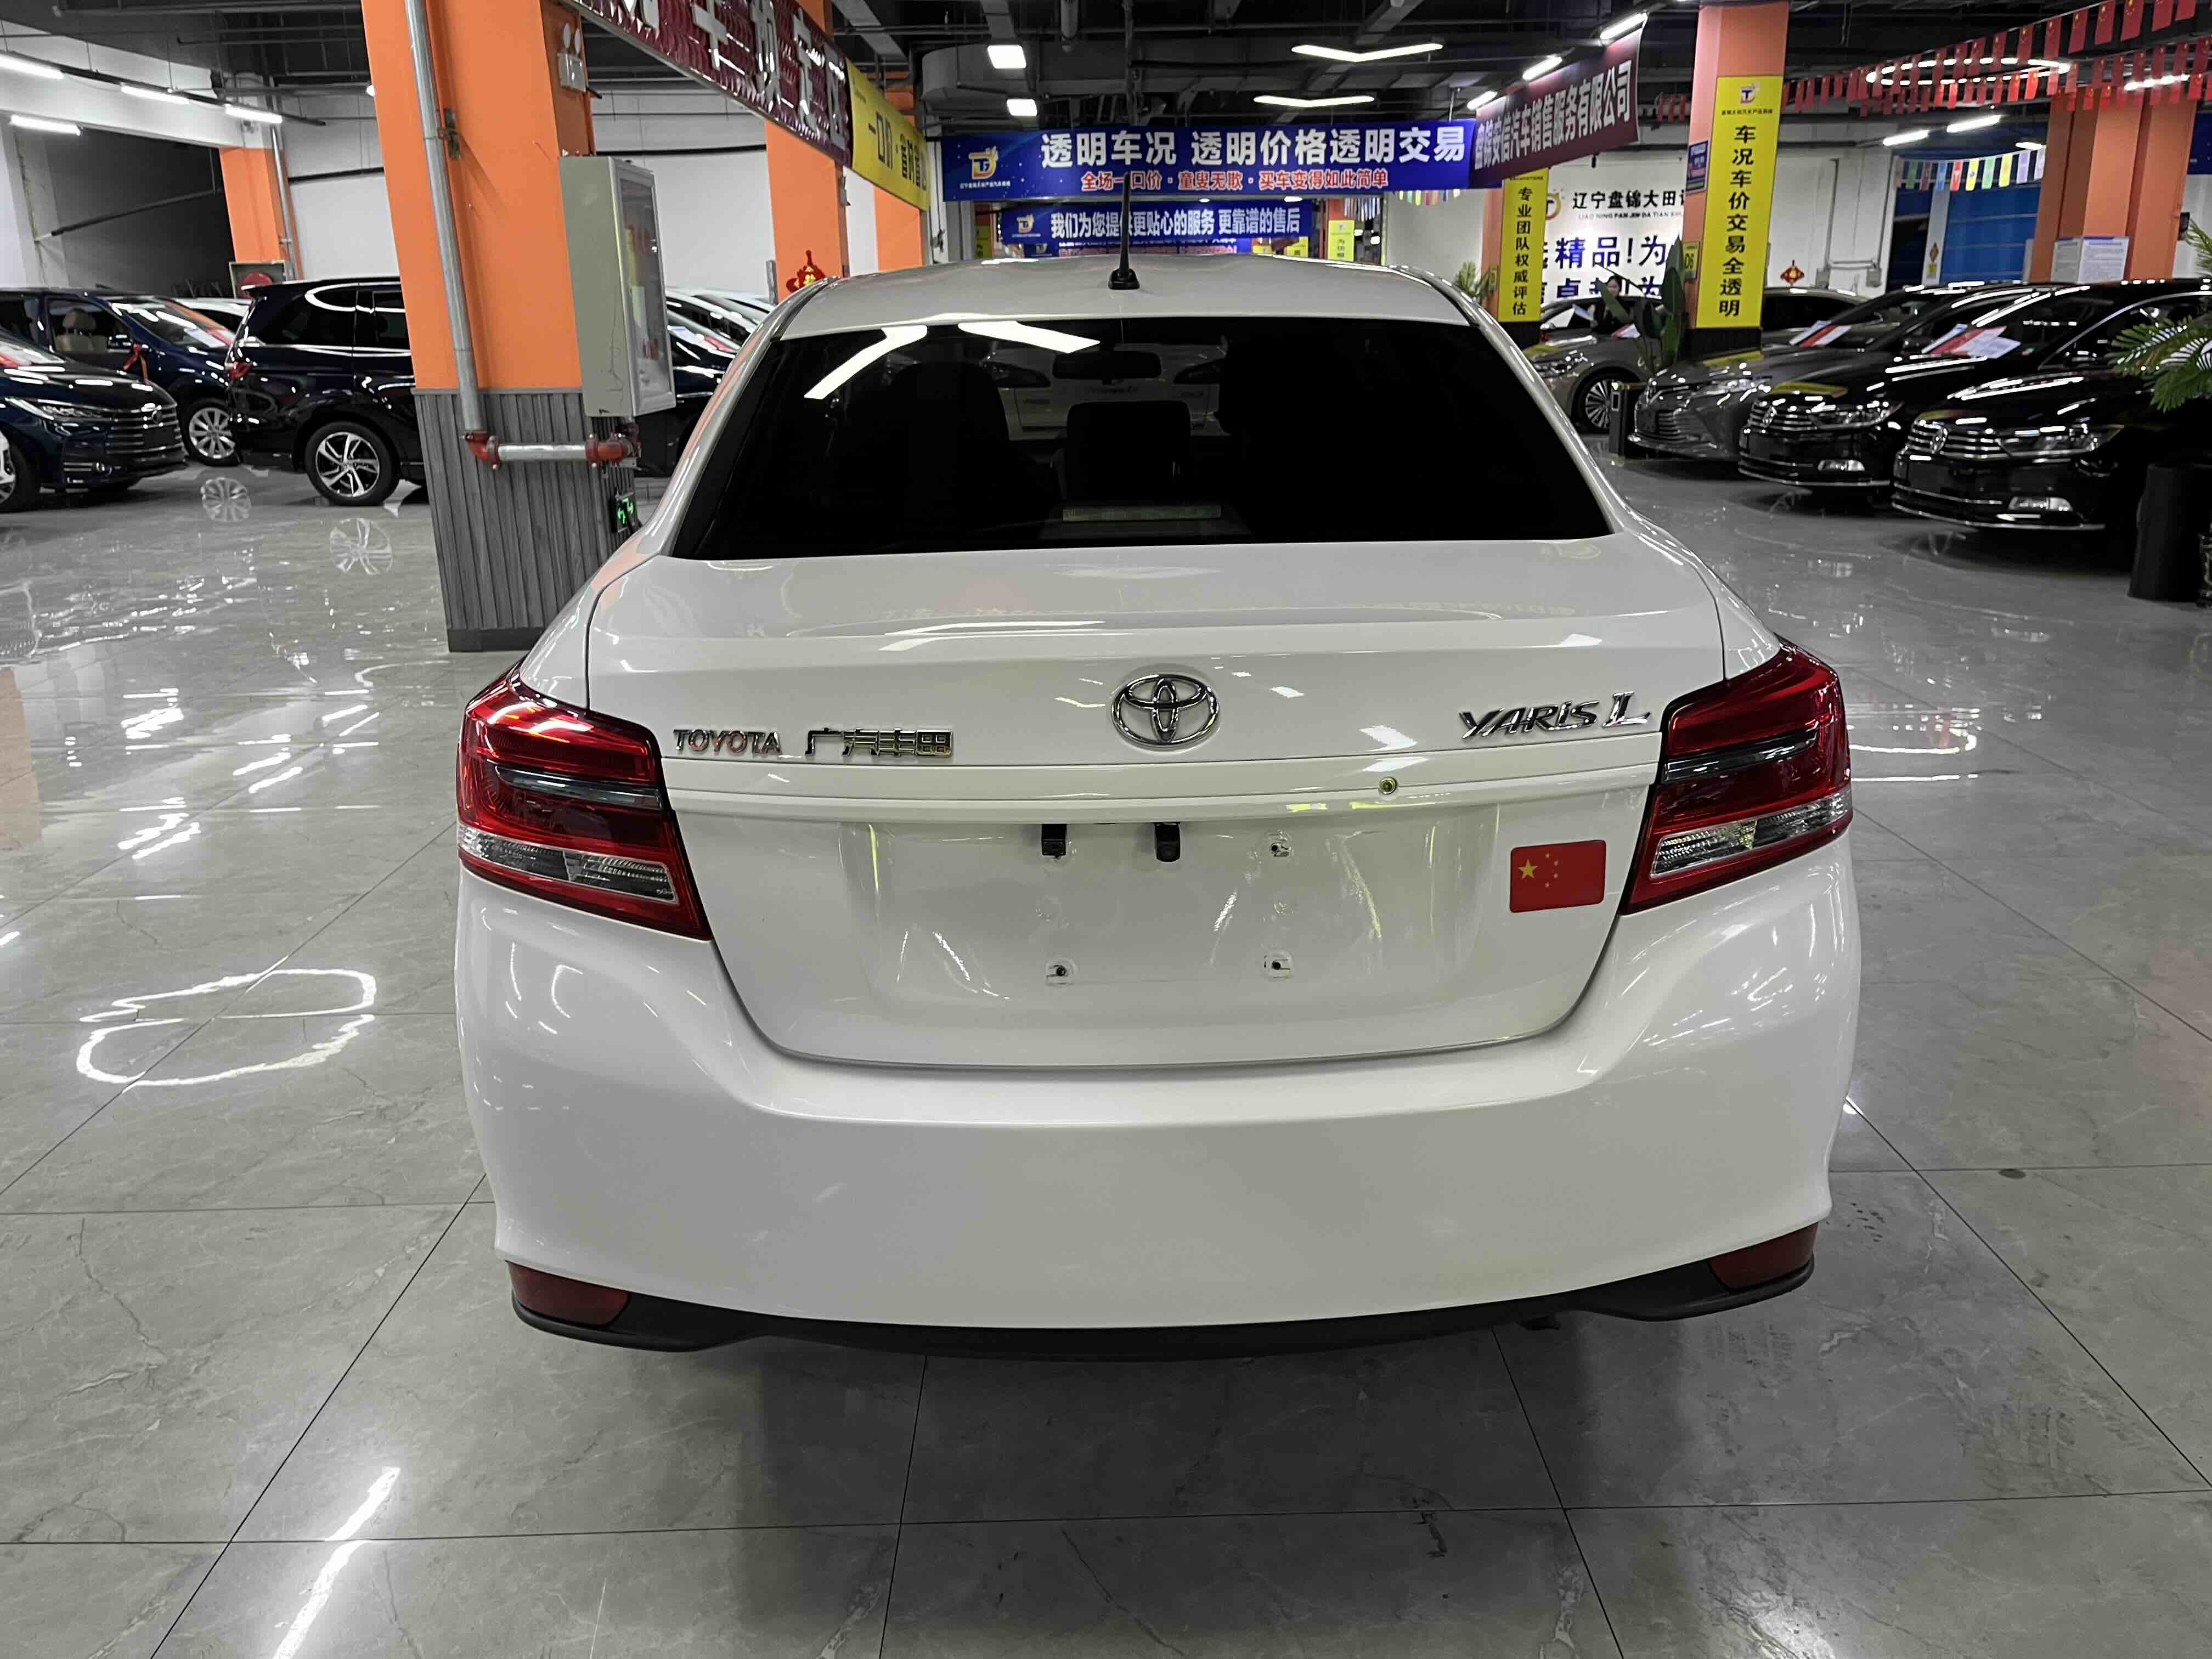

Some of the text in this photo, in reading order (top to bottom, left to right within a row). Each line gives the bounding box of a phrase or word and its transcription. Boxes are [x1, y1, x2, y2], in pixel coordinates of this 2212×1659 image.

[1041, 127, 1465, 167] 透明车况 透明价格透明交易
[1218, 207, 1300, 234] 更靠谱的售后
[1719, 125, 1756, 318] 车况车价交易全透明
[1513, 187, 1533, 315] 专业团队权威评估
[1543, 235, 1667, 269] 精品!为
[1602, 690, 1651, 729] L
[673, 727, 953, 757] TOYOTA 广汽丰田
